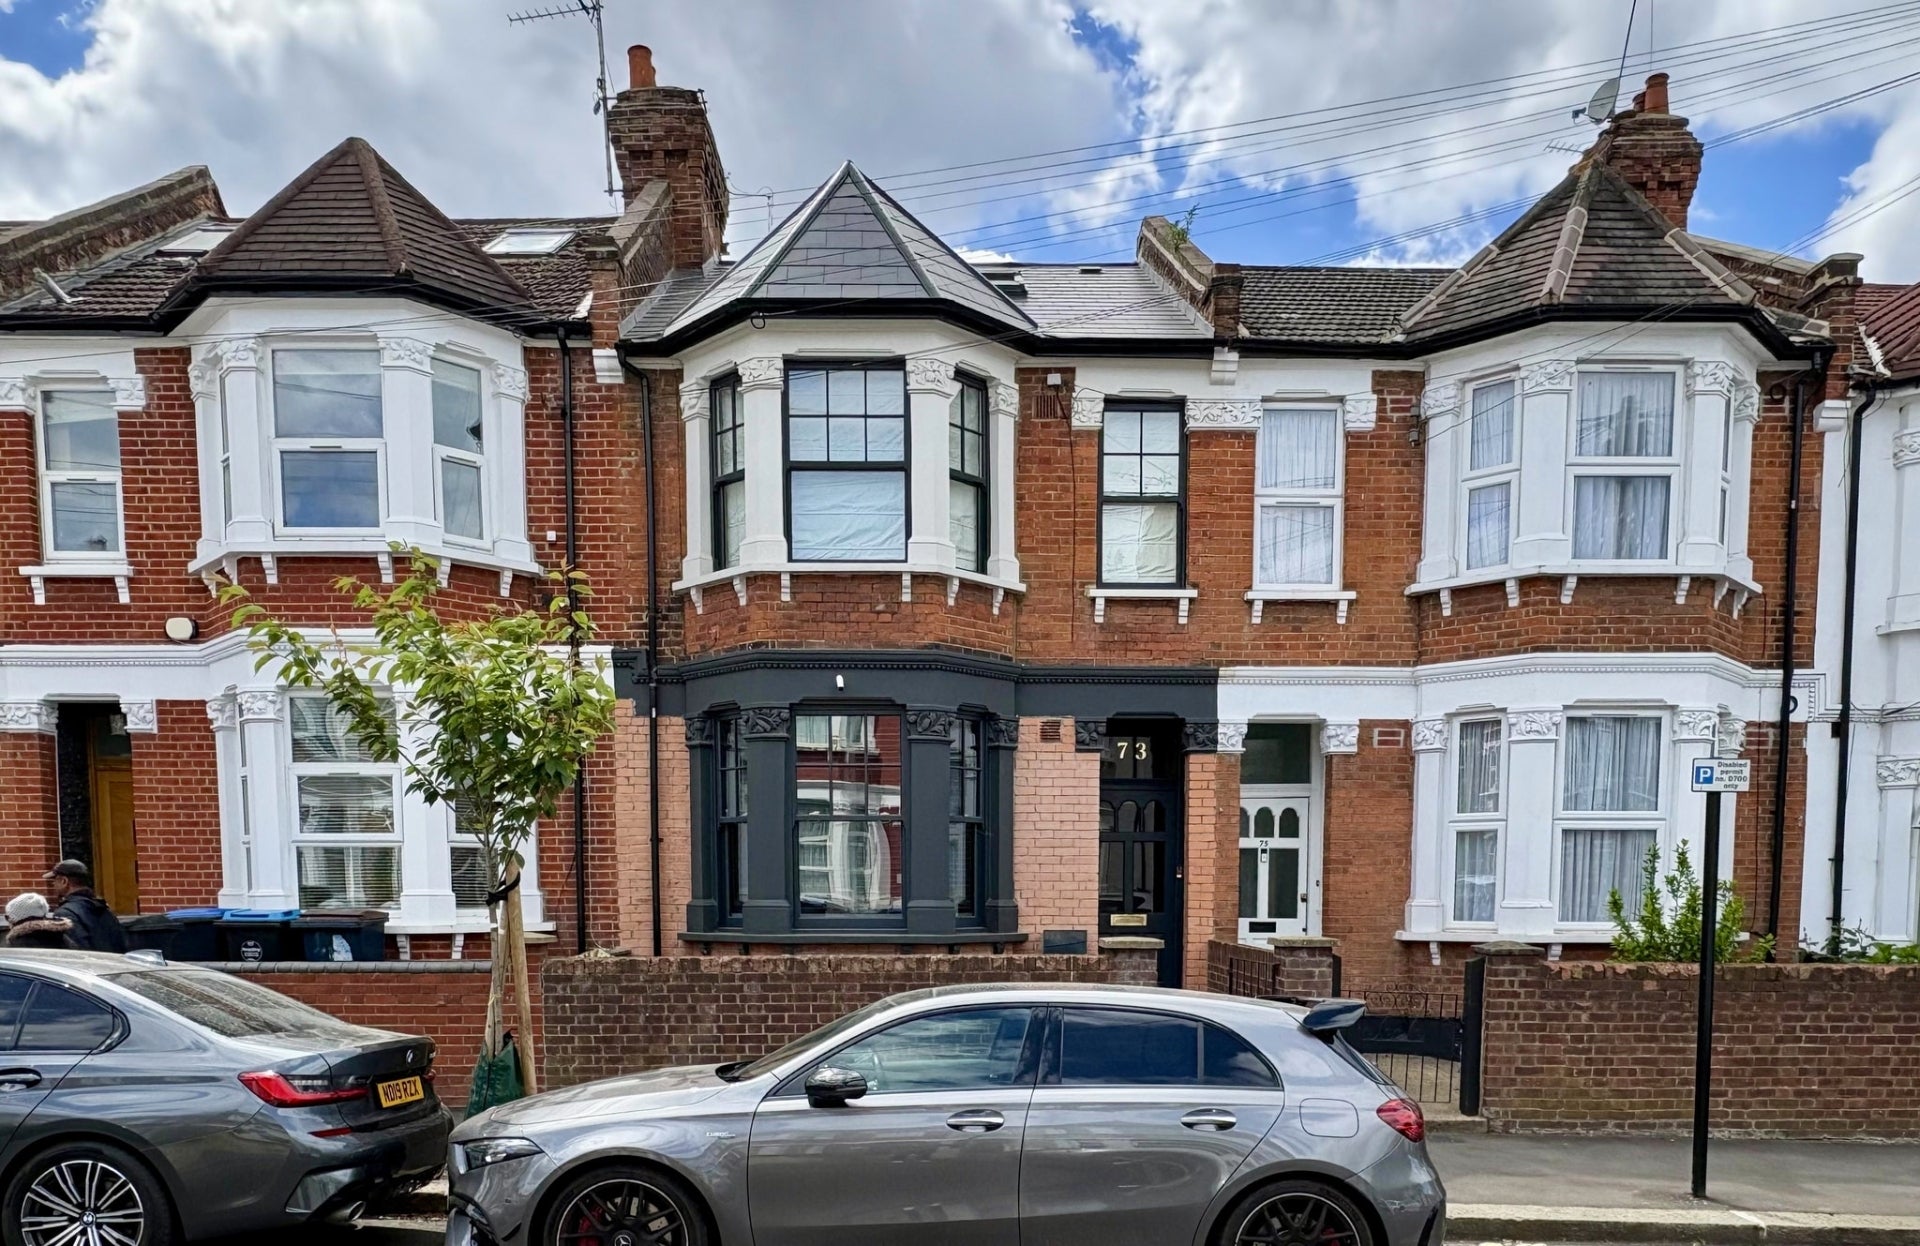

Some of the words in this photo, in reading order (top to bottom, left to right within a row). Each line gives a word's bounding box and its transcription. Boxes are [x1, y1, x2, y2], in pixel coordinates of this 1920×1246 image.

[1117, 742, 1147, 760] 73
[1700, 768, 1711, 782] P
[1259, 840, 1269, 848] 75
[402, 1078, 420, 1099] RZX
